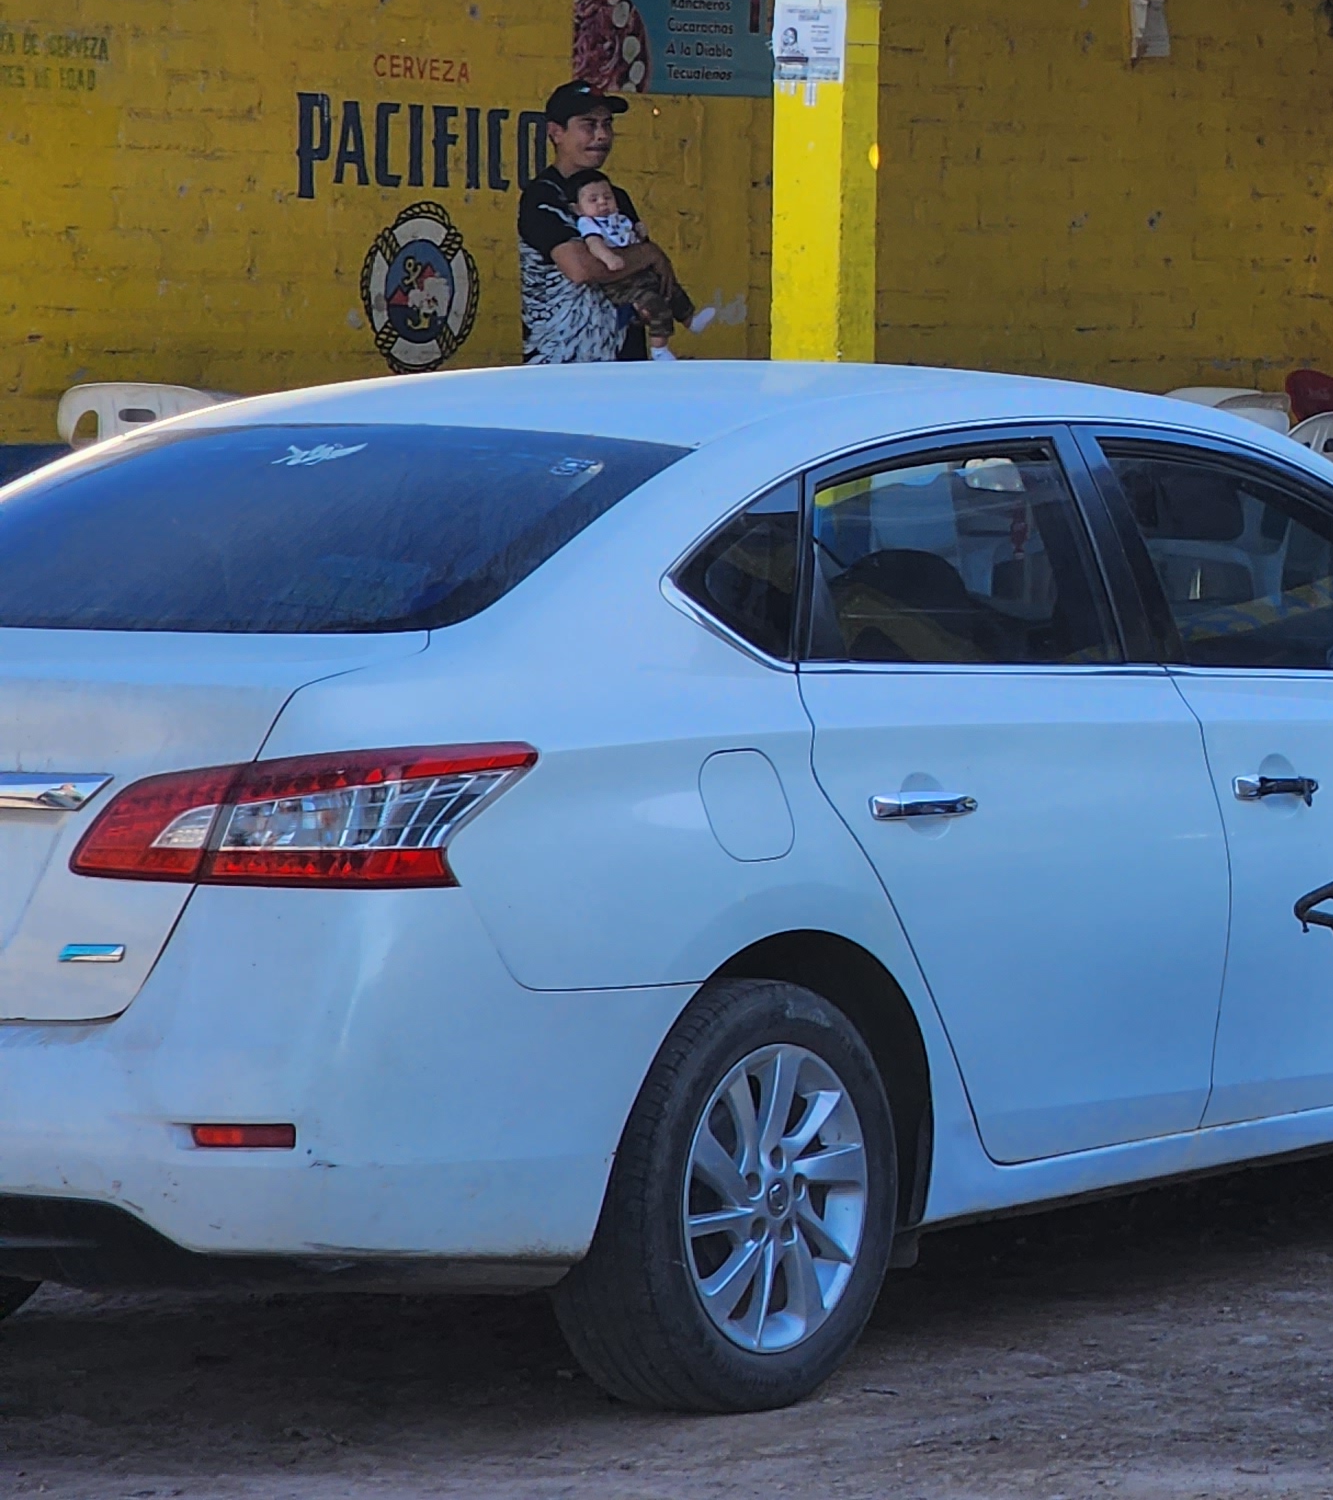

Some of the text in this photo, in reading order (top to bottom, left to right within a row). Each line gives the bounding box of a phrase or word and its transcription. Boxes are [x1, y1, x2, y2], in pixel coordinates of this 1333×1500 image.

[665, 41, 733, 59] A la Diablo
[373, 54, 470, 83] CERVEZA
[296, 91, 548, 199] PACIFICO
